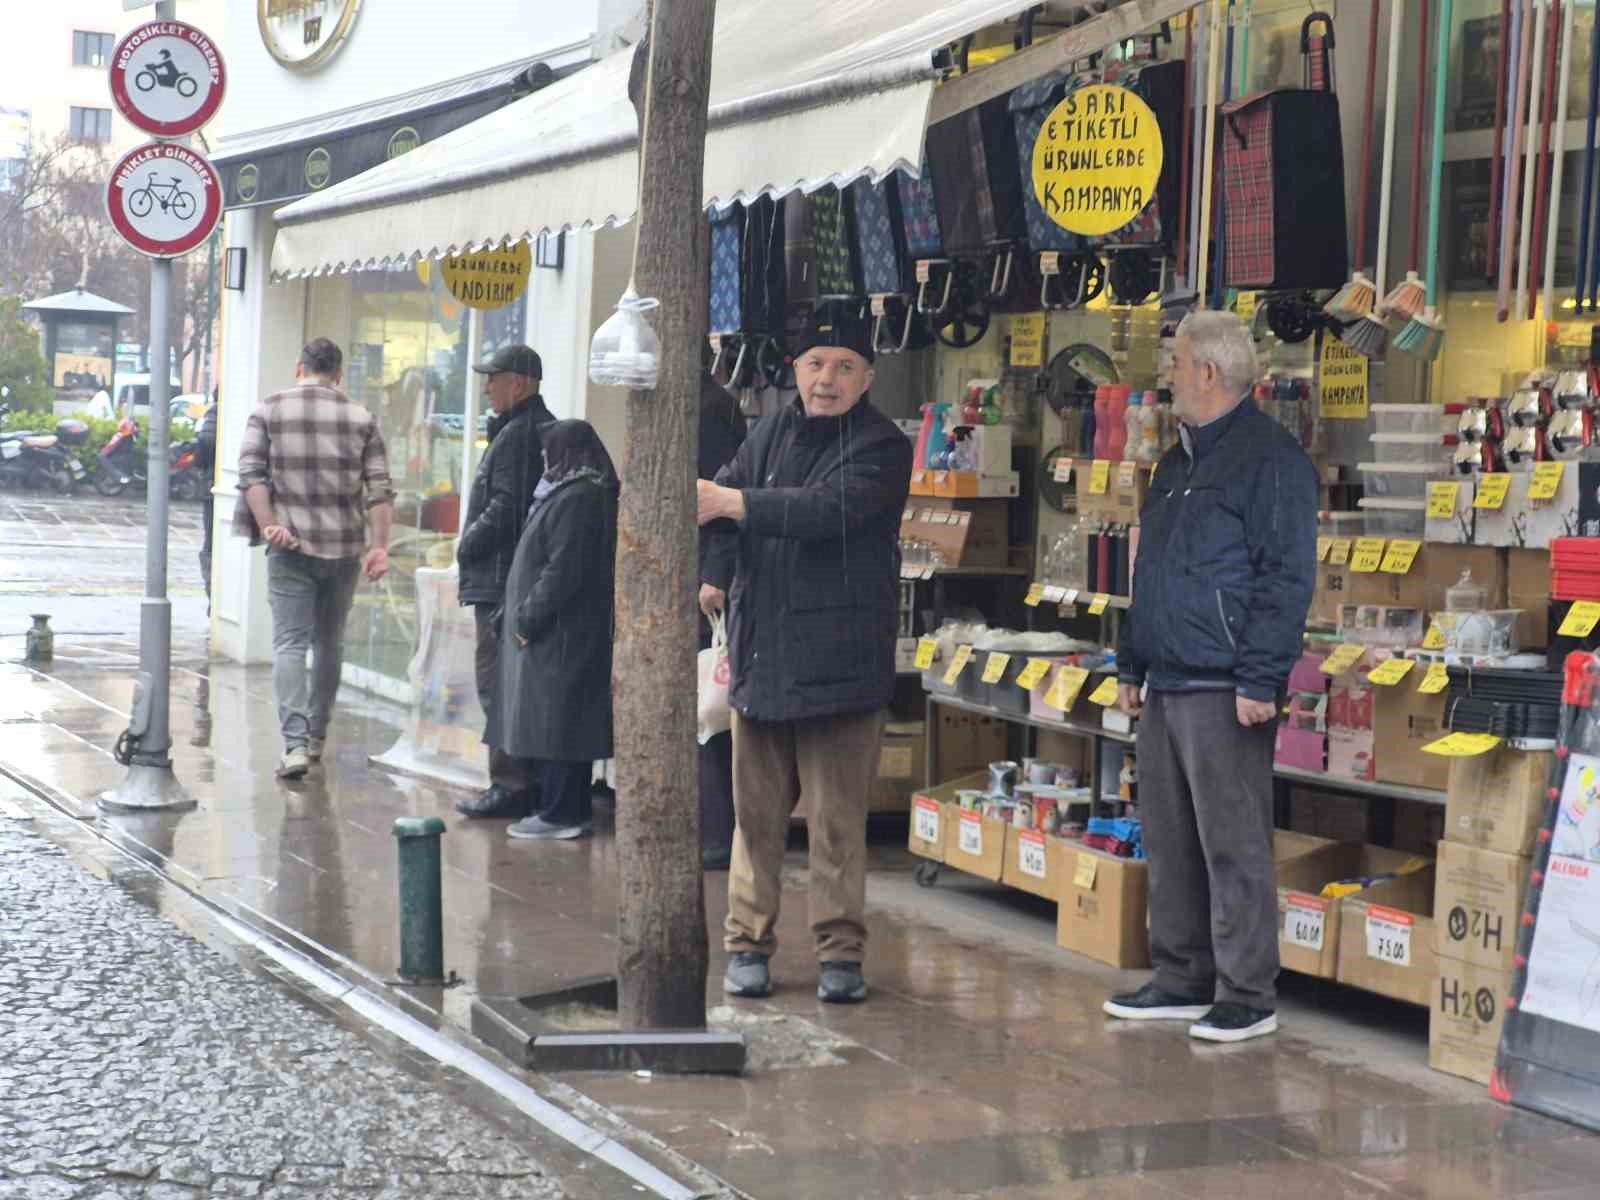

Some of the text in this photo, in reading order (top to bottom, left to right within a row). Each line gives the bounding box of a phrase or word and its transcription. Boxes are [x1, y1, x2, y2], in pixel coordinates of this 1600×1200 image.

[1066, 92, 1126, 115] SARI
[1047, 113, 1139, 141] ETİKETLİ
[1043, 181, 1143, 214] KAMPANYA
